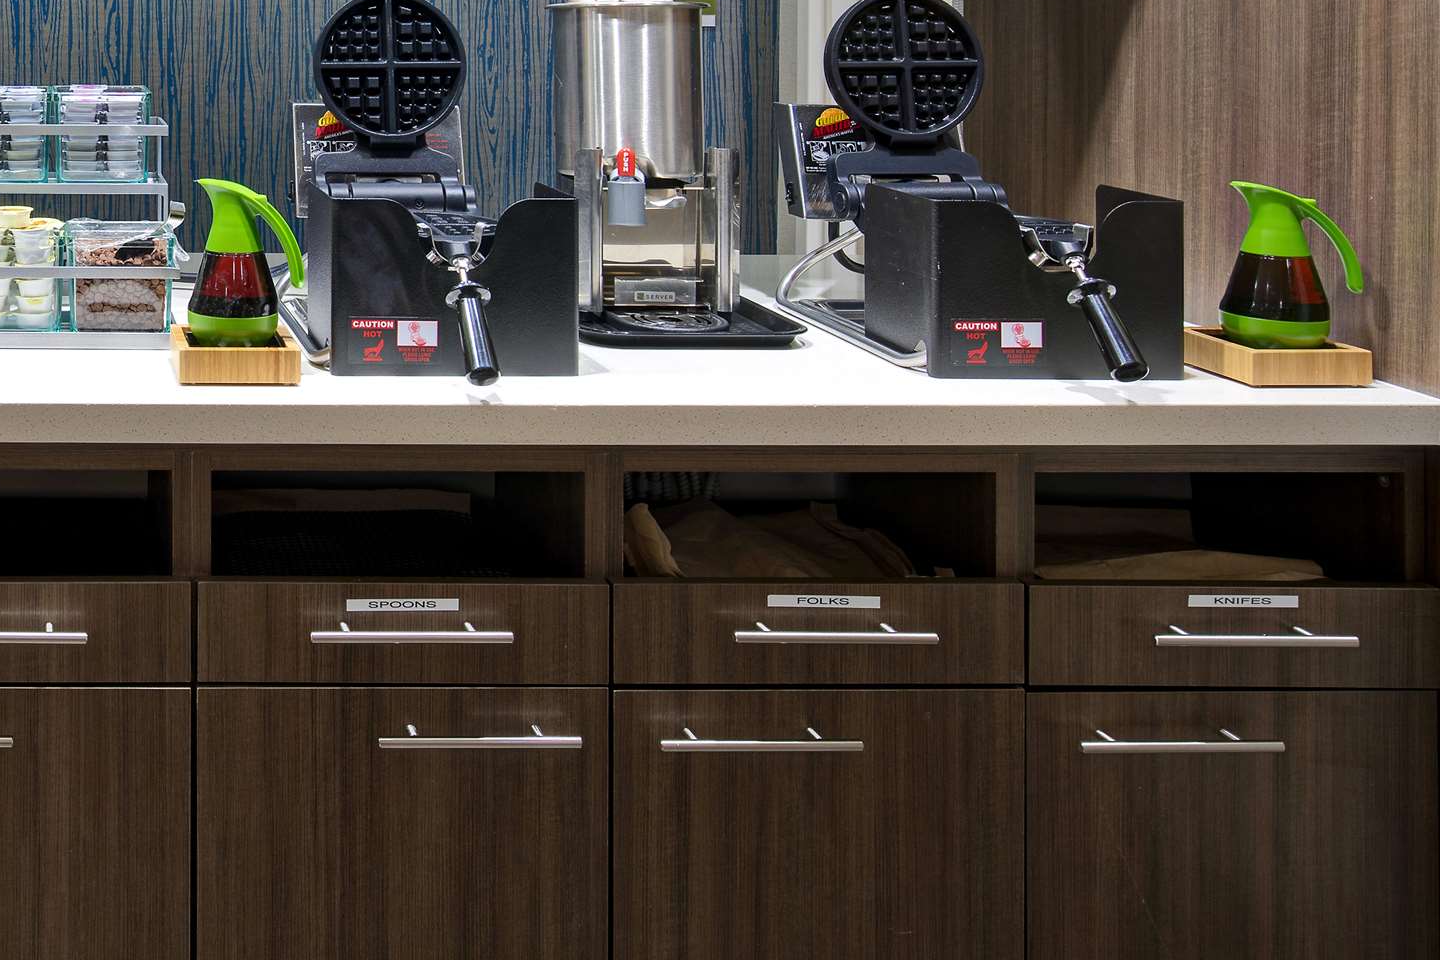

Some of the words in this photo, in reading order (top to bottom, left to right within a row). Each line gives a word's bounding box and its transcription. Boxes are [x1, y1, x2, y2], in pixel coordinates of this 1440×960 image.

[955, 322, 998, 330] CAUTION
[797, 597, 850, 605] FOLKS
[1213, 597, 1272, 605] KNIFES
